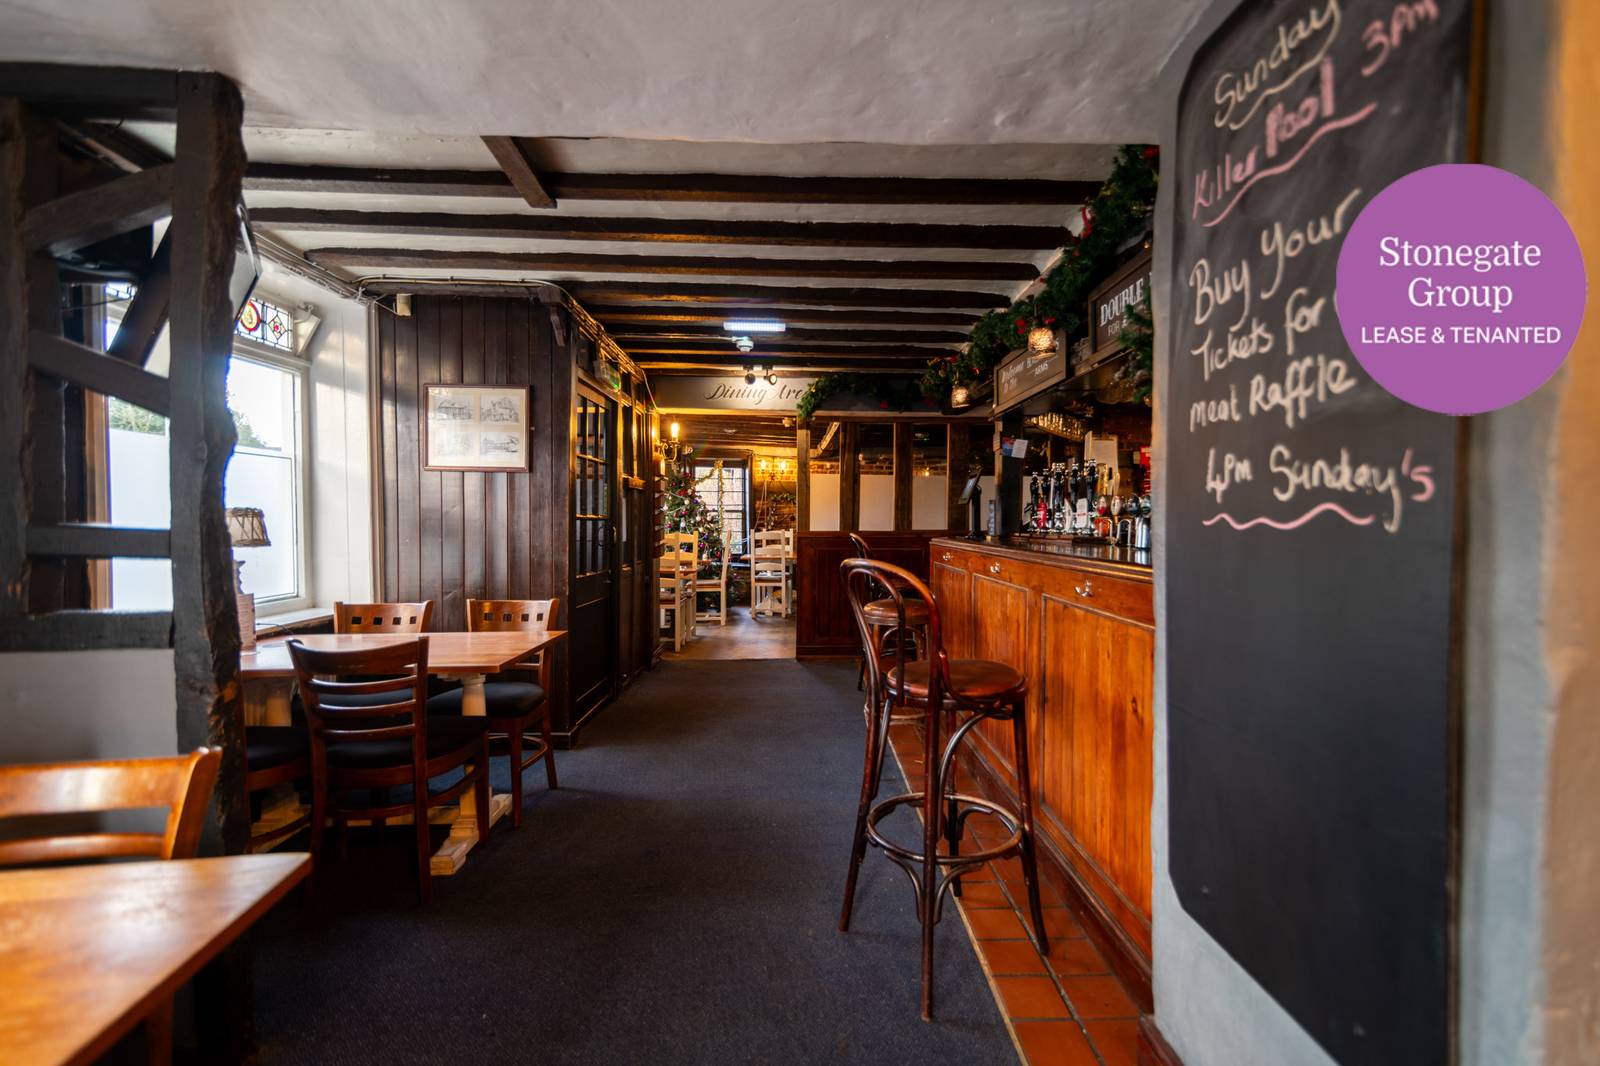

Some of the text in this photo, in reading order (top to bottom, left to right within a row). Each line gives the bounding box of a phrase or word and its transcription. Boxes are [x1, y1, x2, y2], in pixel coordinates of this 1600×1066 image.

[1214, 0, 1341, 130] Sunday
[1192, 56, 1335, 219] Killer Pool
[1100, 278, 1144, 327] DOUBLE
[1189, 258, 1250, 332] Buy
[1191, 288, 1326, 381] Tickets for
[704, 383, 808, 405] Dining Are
[1249, 353, 1358, 429] Raffle
[1269, 444, 1436, 534] Sunday's
